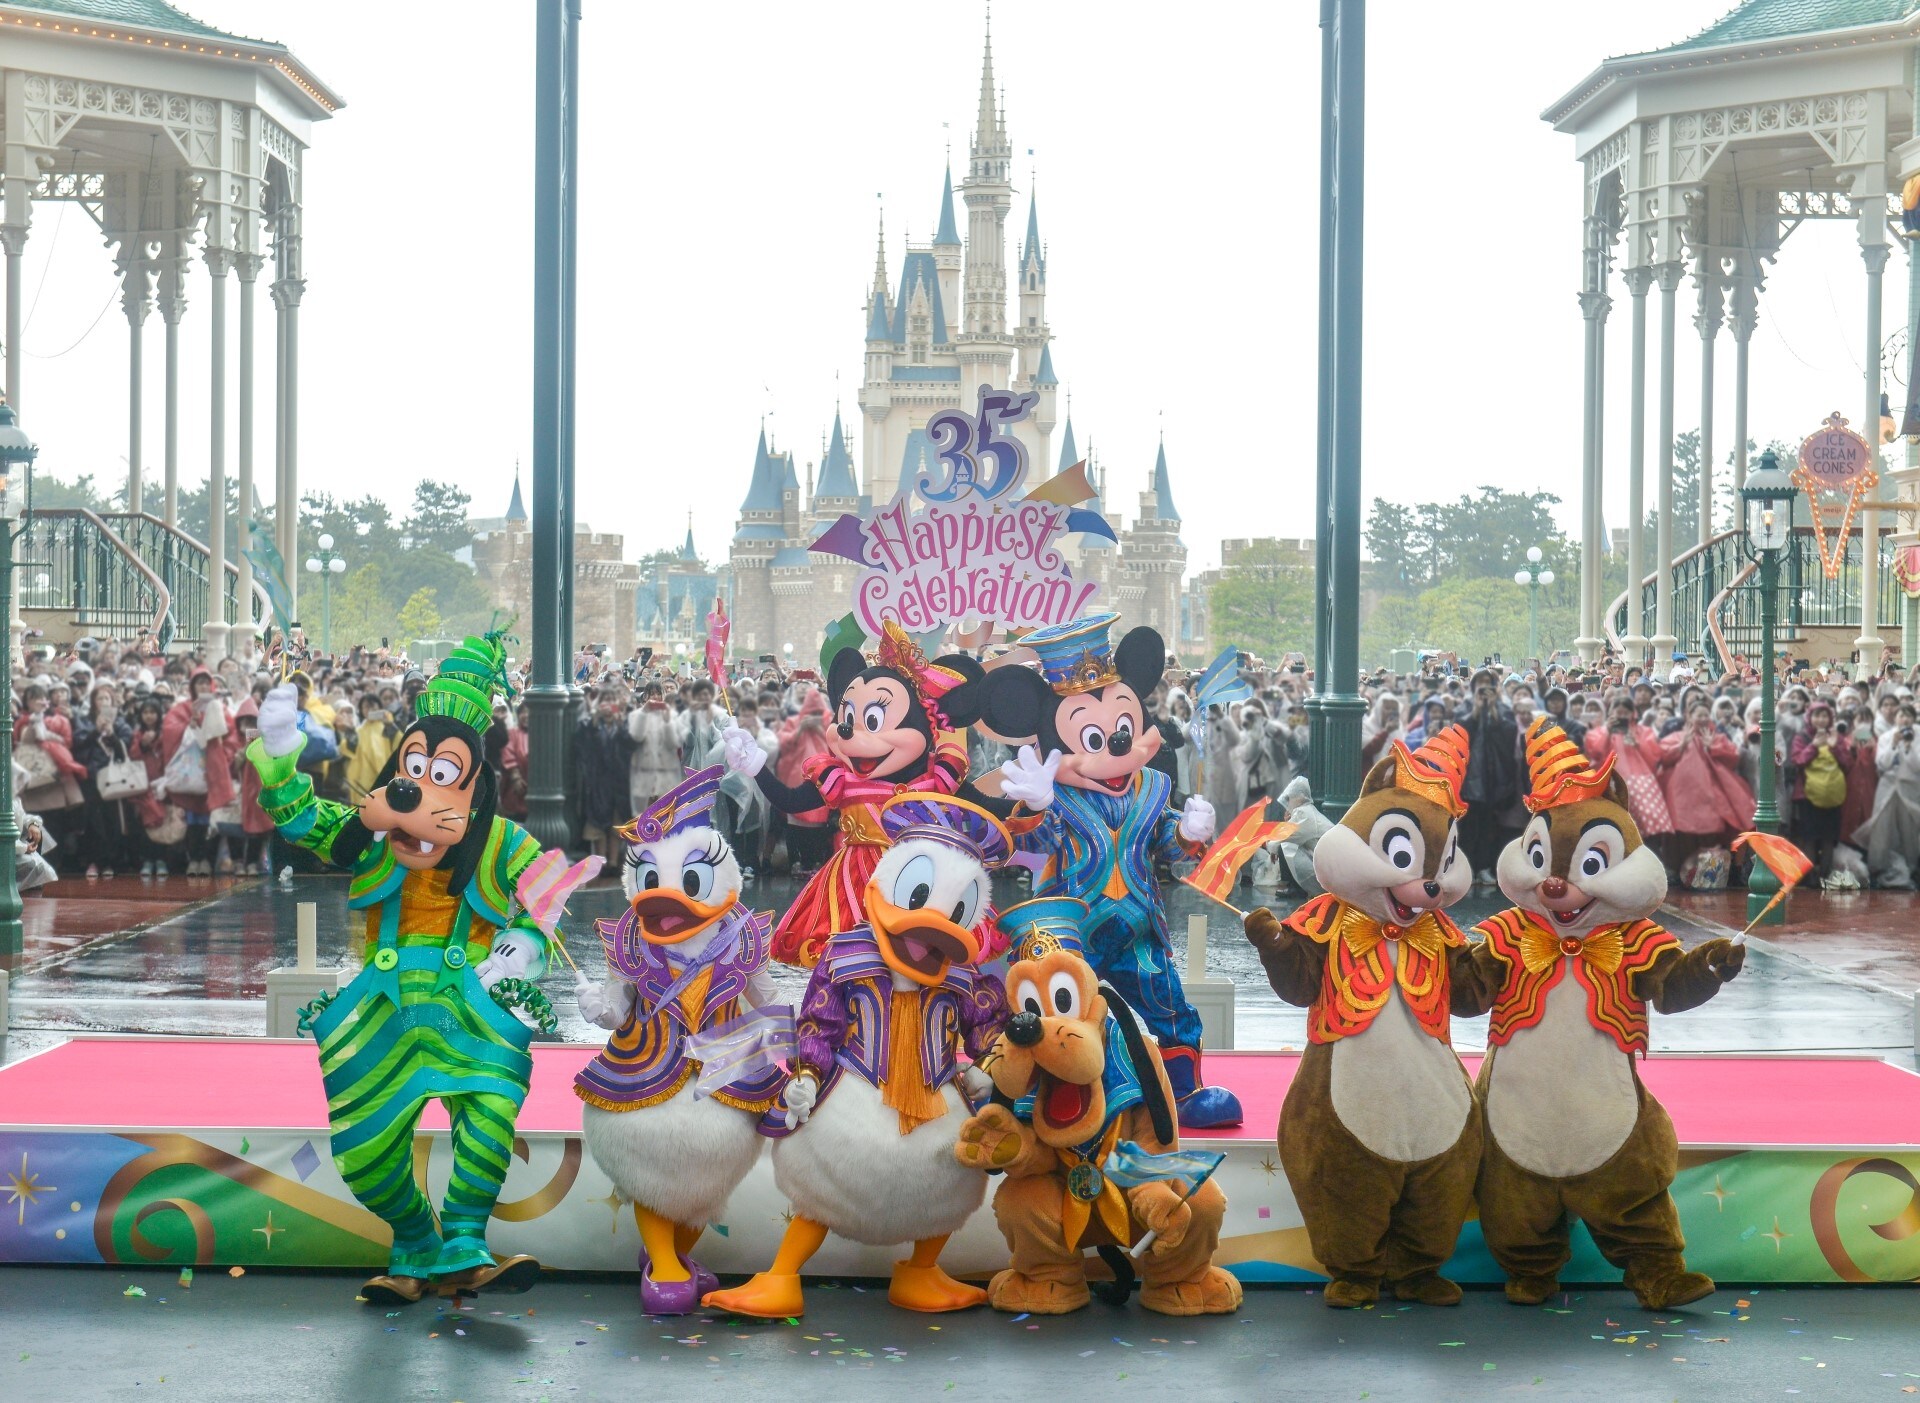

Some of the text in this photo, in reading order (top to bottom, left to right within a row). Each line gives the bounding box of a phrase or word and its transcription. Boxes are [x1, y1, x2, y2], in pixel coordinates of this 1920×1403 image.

[919, 396, 1032, 502] 35
[1812, 447, 1856, 460] CREAM
[1826, 433, 1845, 446] ICE
[1813, 461, 1854, 474] CONES
[867, 498, 1062, 574] Happiest
[860, 561, 1097, 637] Celebration!
